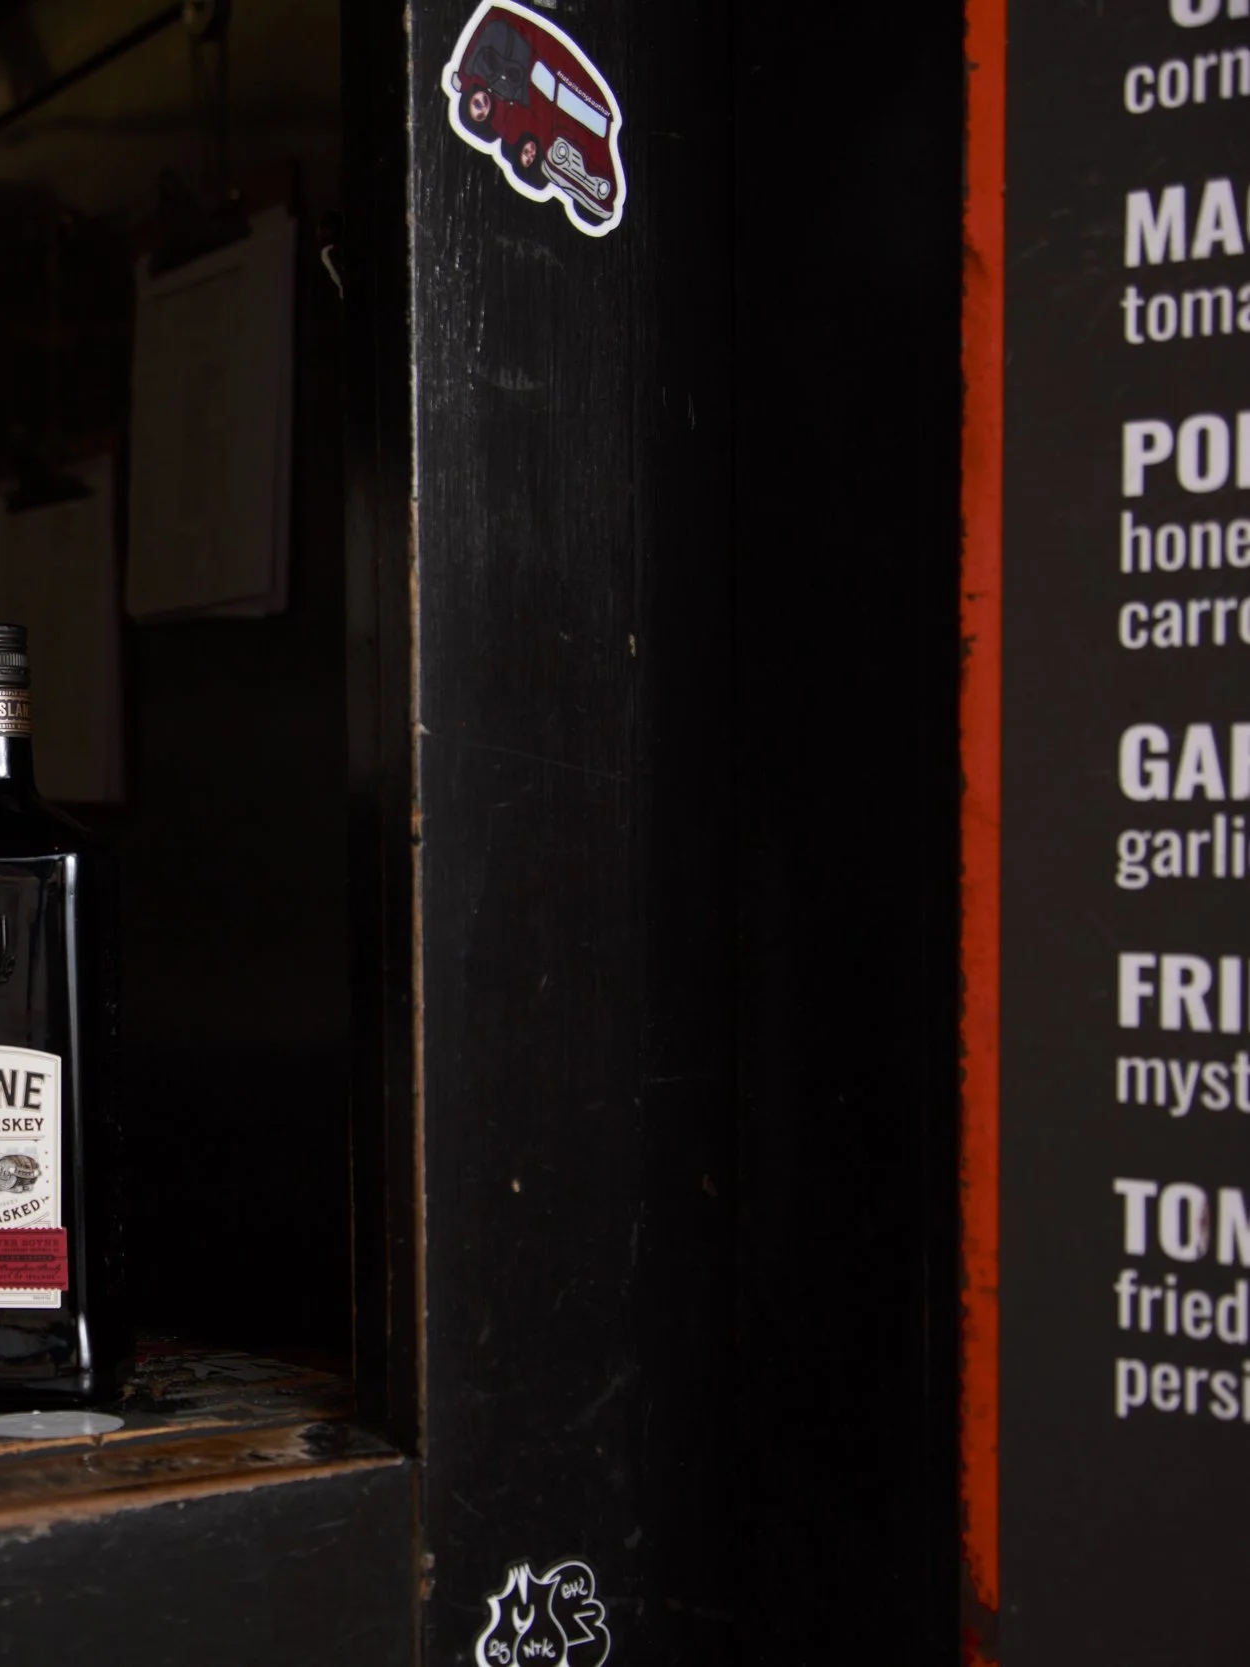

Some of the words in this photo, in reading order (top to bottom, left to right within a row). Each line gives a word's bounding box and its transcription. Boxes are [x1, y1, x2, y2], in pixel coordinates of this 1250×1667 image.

[1123, 45, 1250, 115] corn
[1124, 177, 1250, 269] MA
[1120, 509, 1250, 575] hone
[1114, 811, 1250, 891] garli
[1117, 951, 1250, 1035] FRI
[1115, 1049, 1250, 1119] myst
[1113, 1267, 1249, 1346] fried
[1114, 1356, 1250, 1425] persi
